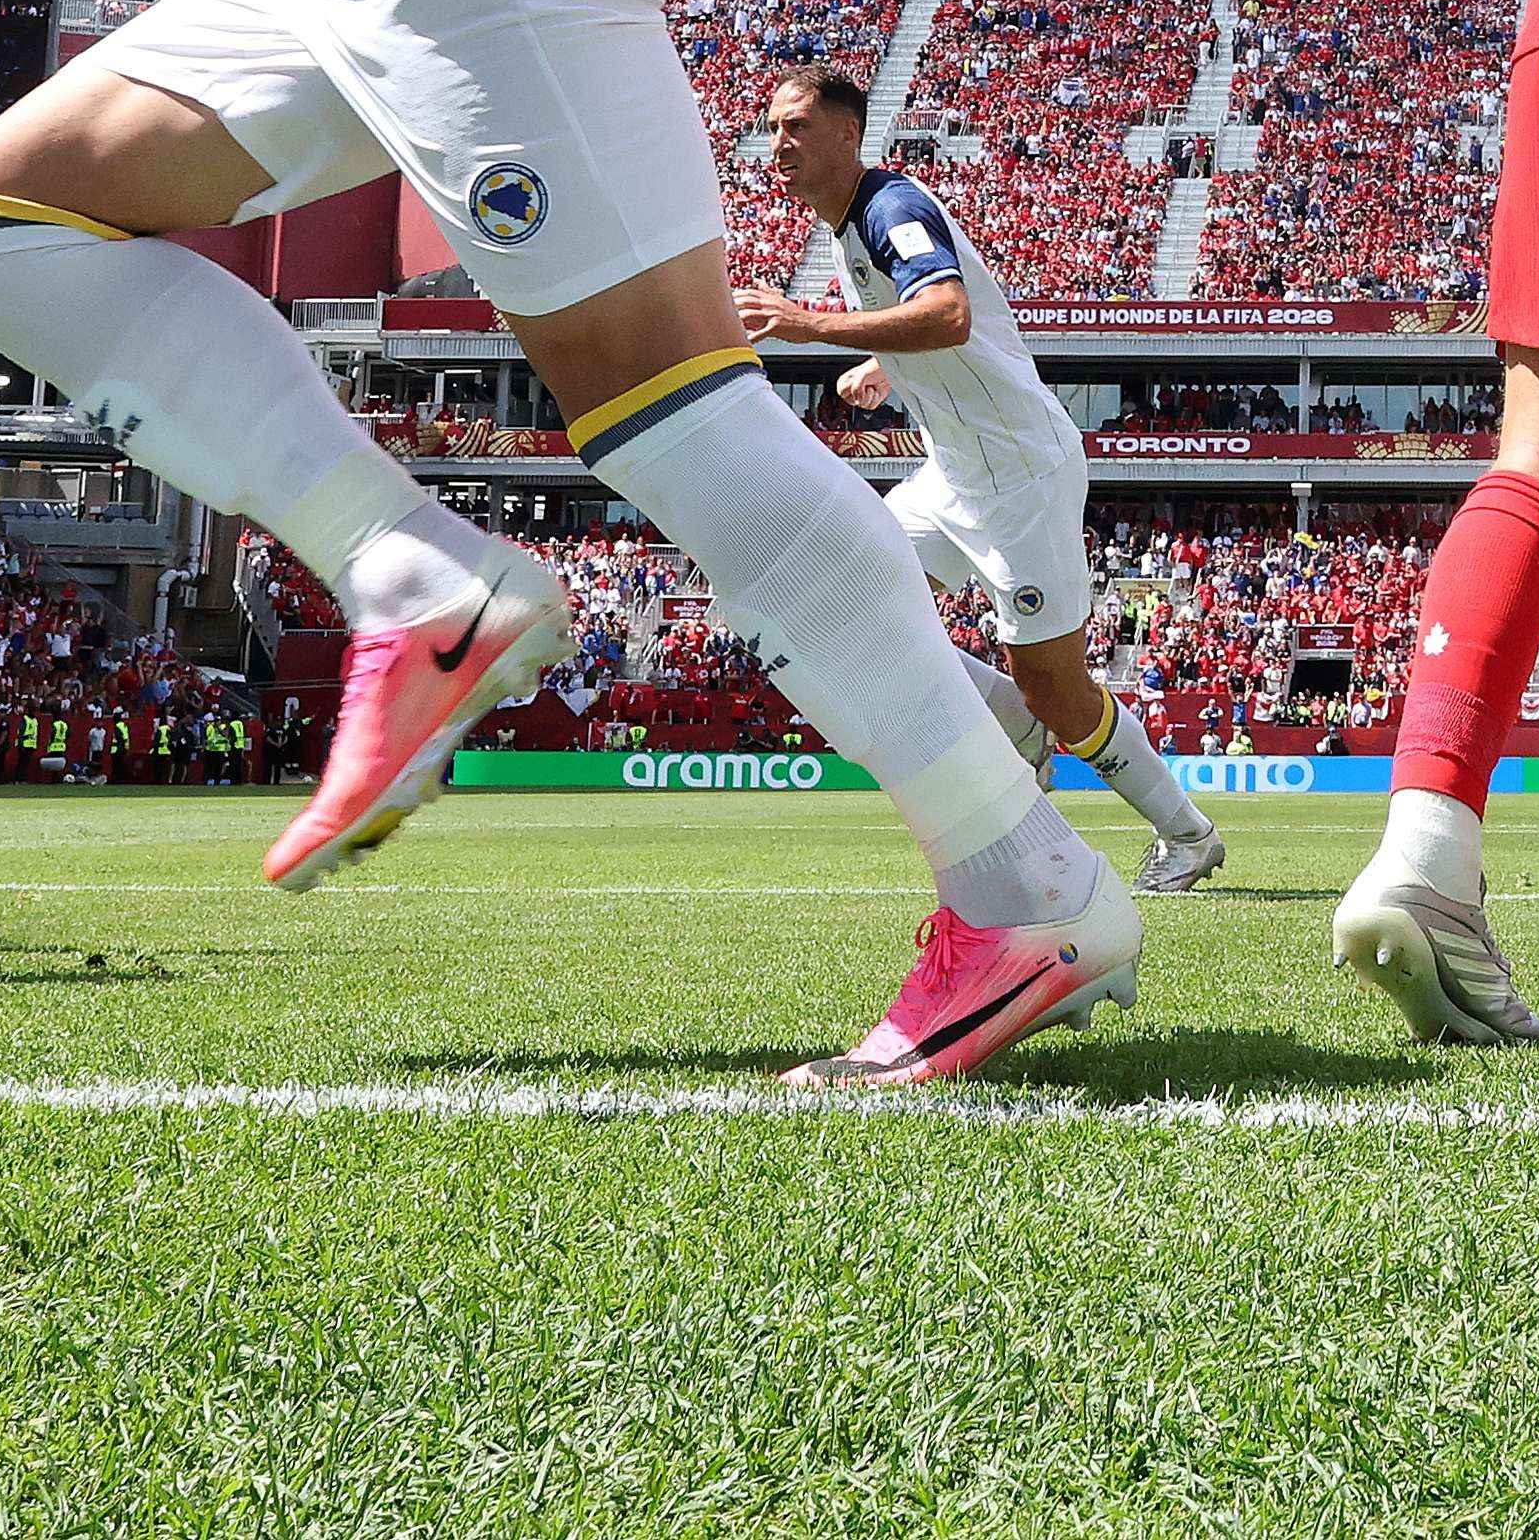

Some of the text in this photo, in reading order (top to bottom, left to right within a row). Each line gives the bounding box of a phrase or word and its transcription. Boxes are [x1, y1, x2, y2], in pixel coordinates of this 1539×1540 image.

[1070, 309, 1095, 325] DU
[1099, 309, 1166, 325] MONDE
[1169, 309, 1191, 325] DE
[1196, 309, 1221, 325] LA
[1223, 309, 1264, 325] FIFA
[1267, 309, 1334, 325] 2026
[1096, 437, 1251, 453] TORONTO
[623, 753, 823, 789] aramco
[1167, 756, 1315, 792] ramco
